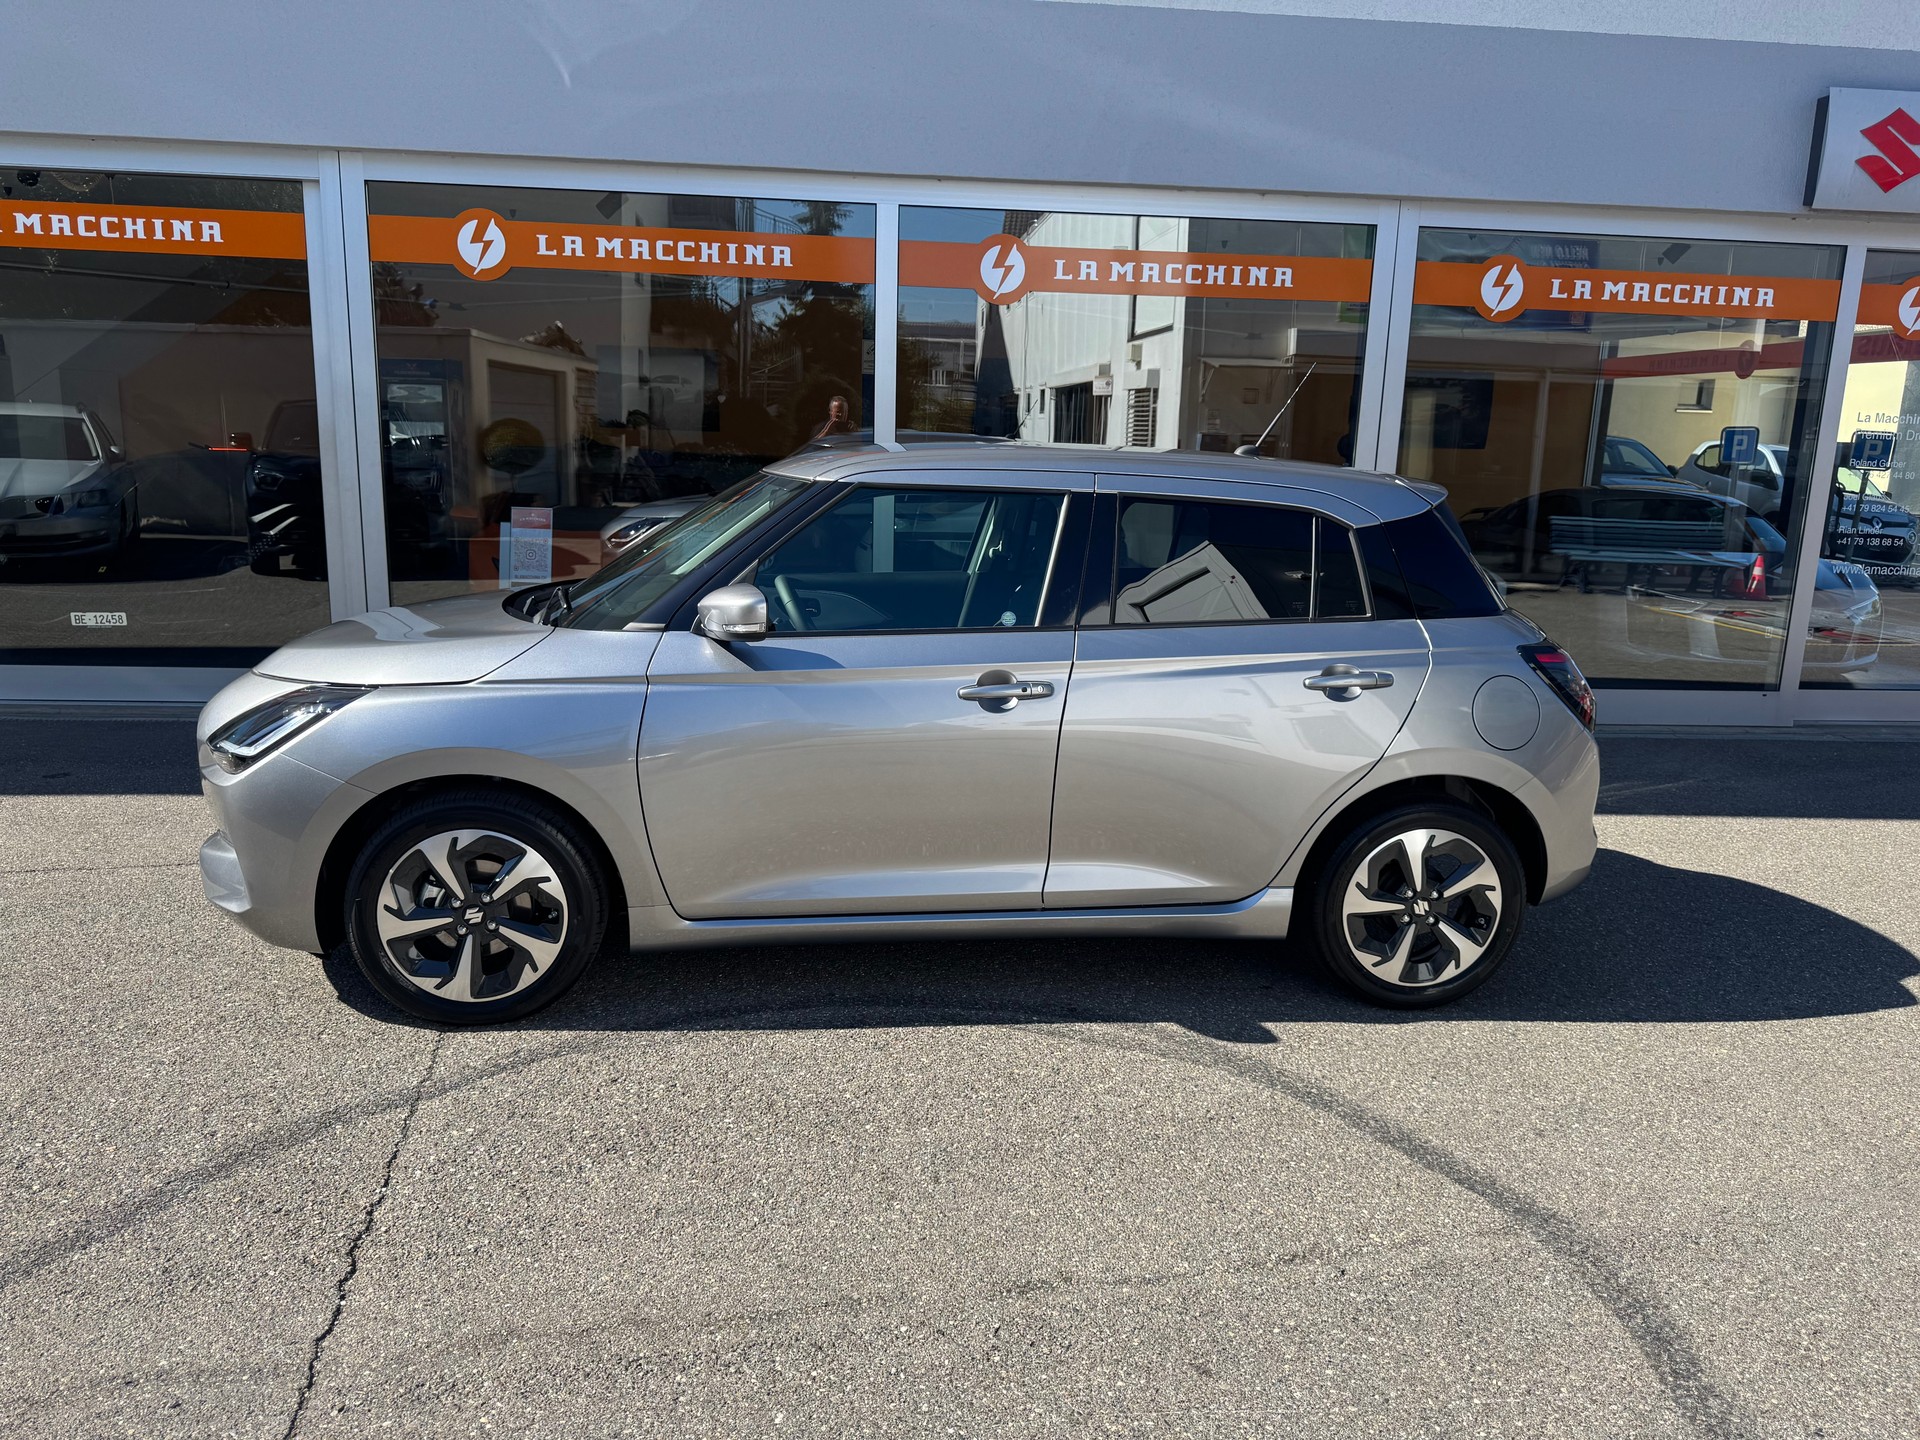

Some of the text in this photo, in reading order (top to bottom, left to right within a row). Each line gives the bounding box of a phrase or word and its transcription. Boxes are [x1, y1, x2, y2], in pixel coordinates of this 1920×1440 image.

[13, 212, 224, 243] MACCHINA
[536, 234, 793, 267] LA MACCHINA
[1053, 259, 1293, 288] LA MACCHINA
[1549, 279, 1774, 307] LA MACCHINA
[1857, 412, 1871, 423] La
[1856, 428, 1903, 441] remium
[1732, 435, 1748, 459] P
[1862, 440, 1883, 463] P
[1849, 458, 1906, 469] Roland Gerber
[1892, 471, 1903, 480] 44
[1842, 503, 1857, 512] +41
[1859, 504, 1870, 513] 79
[1870, 505, 1886, 513] 824
[1836, 537, 1851, 545] +41
[1853, 537, 1864, 546] 79
[1866, 538, 1881, 546] 138
[1881, 538, 1892, 546] 68
